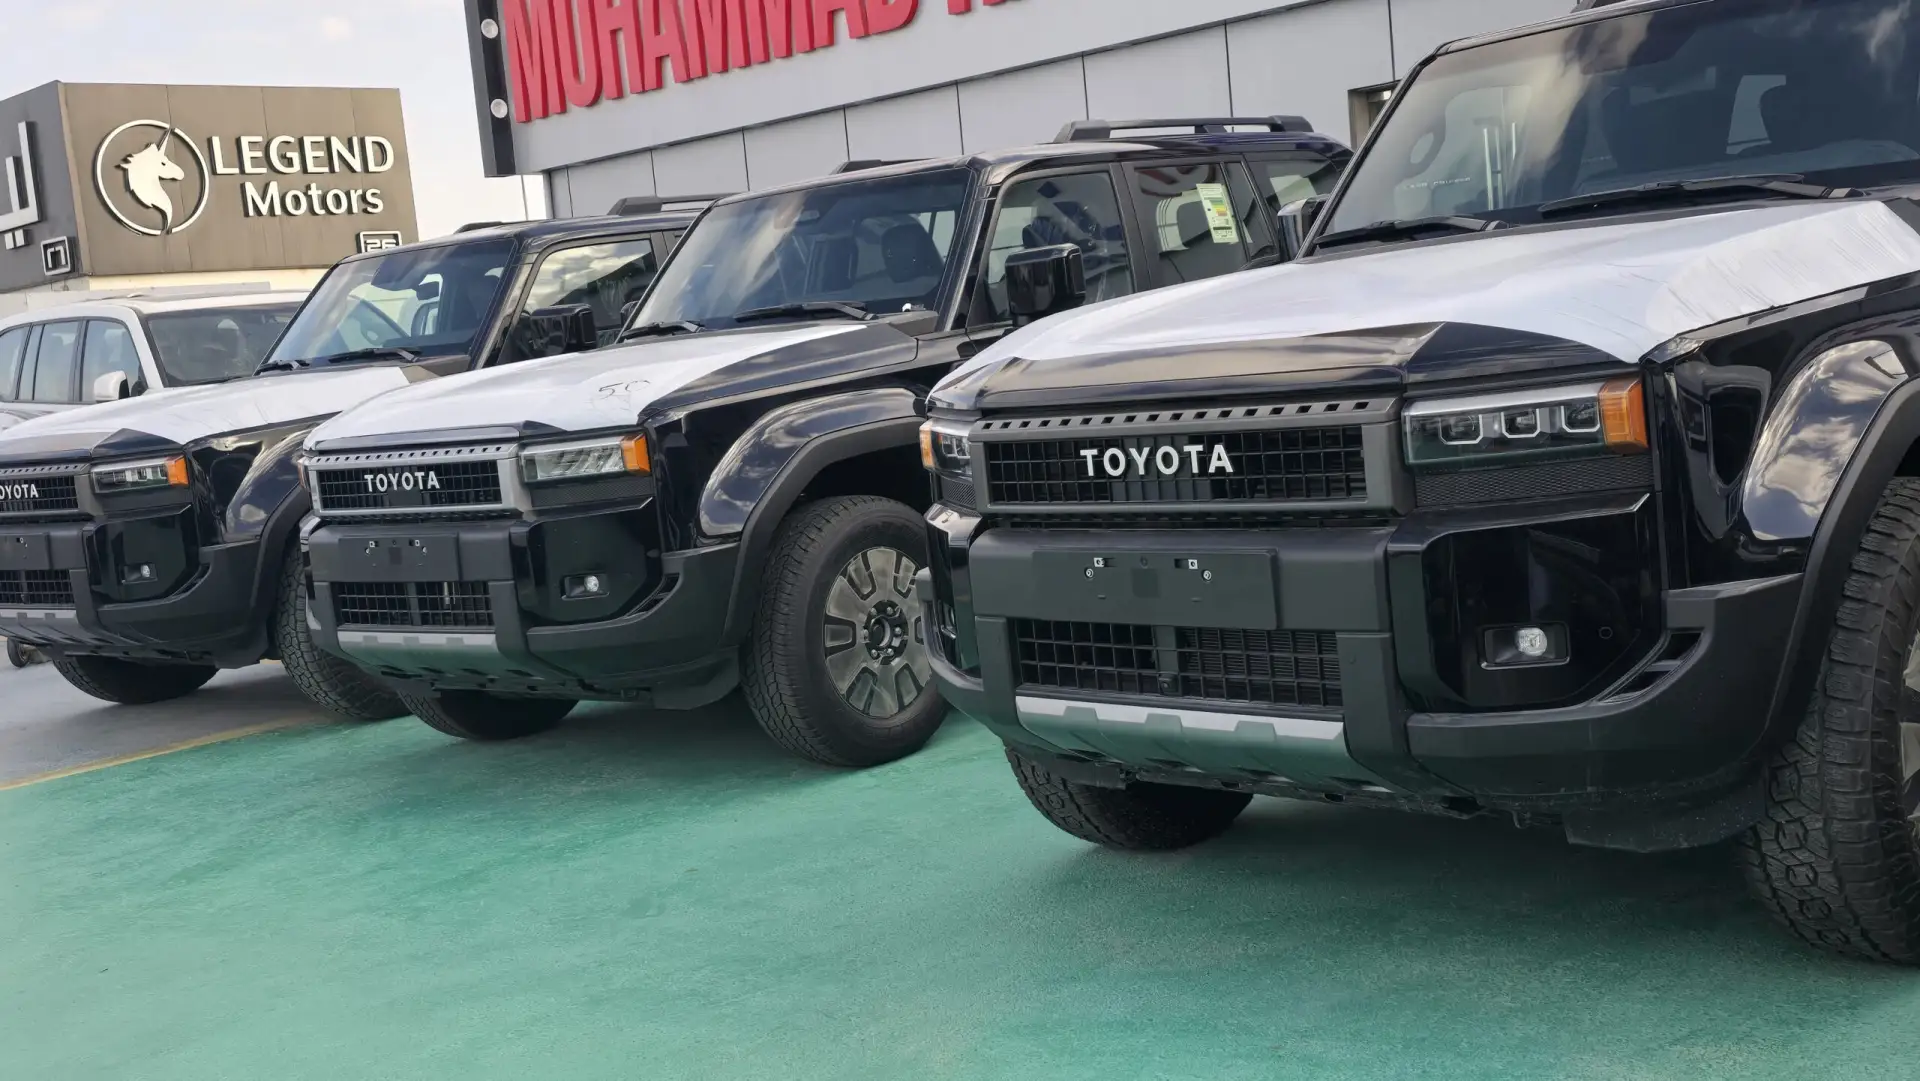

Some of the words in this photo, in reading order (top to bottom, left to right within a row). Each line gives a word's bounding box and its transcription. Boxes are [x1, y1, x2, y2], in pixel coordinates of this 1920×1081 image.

[501, 0, 920, 123] MUHAM
[210, 135, 395, 175] LEGEND
[243, 180, 384, 217] Motors
[1079, 444, 1234, 477] TOYOTA
[363, 470, 441, 493] TOYOTA
